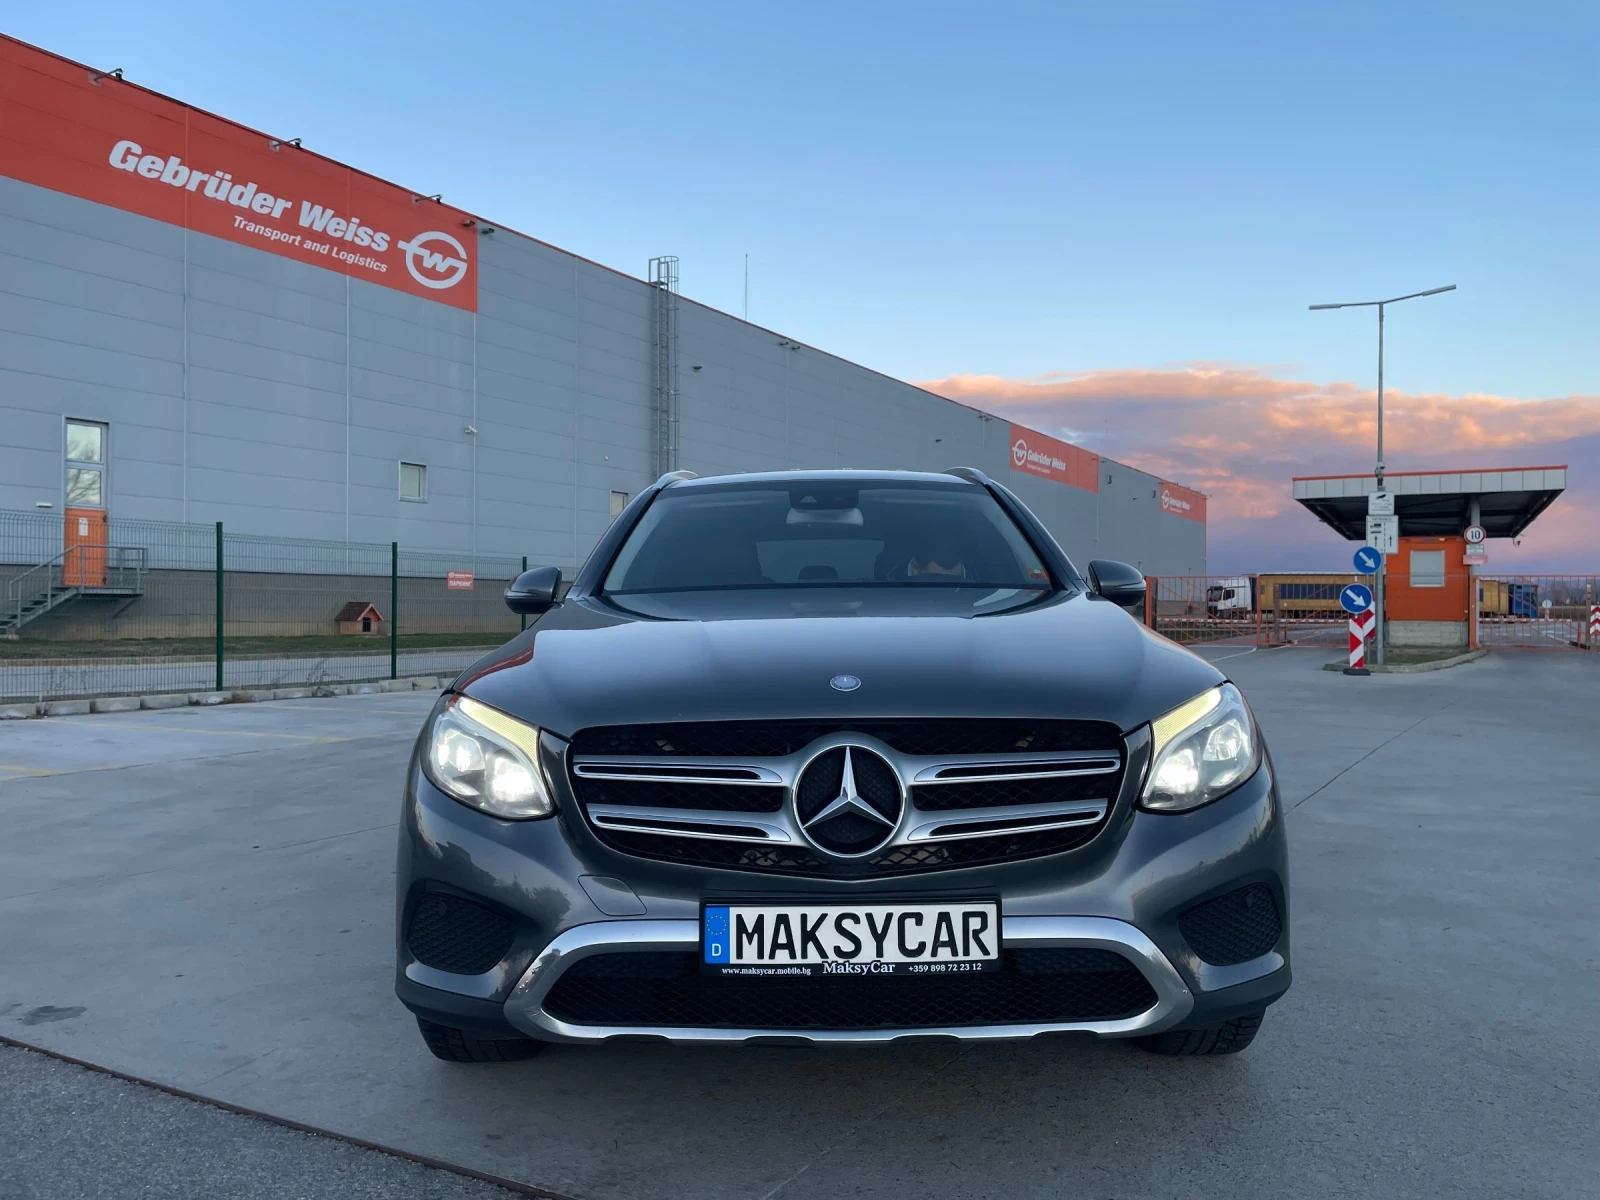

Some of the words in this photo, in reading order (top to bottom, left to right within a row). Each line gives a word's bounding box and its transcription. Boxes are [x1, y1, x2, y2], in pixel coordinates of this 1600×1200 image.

[108, 139, 293, 220] Gebrüder
[297, 200, 391, 252] Weiss
[233, 215, 302, 246] Transport
[303, 239, 330, 255] and
[331, 246, 388, 273] Logistics
[1471, 530, 1481, 540] 10
[735, 911, 991, 960] MAKSYCAR
[711, 943, 722, 957] D
[721, 967, 812, 976] www.maksycar.mobile.bg
[822, 961, 896, 976] MaksyCar
[908, 964, 928, 973] +359
[930, 964, 946, 972] 898
[947, 964, 958, 972] 72
[959, 963, 970, 971] 23
[972, 962, 982, 971] 12
